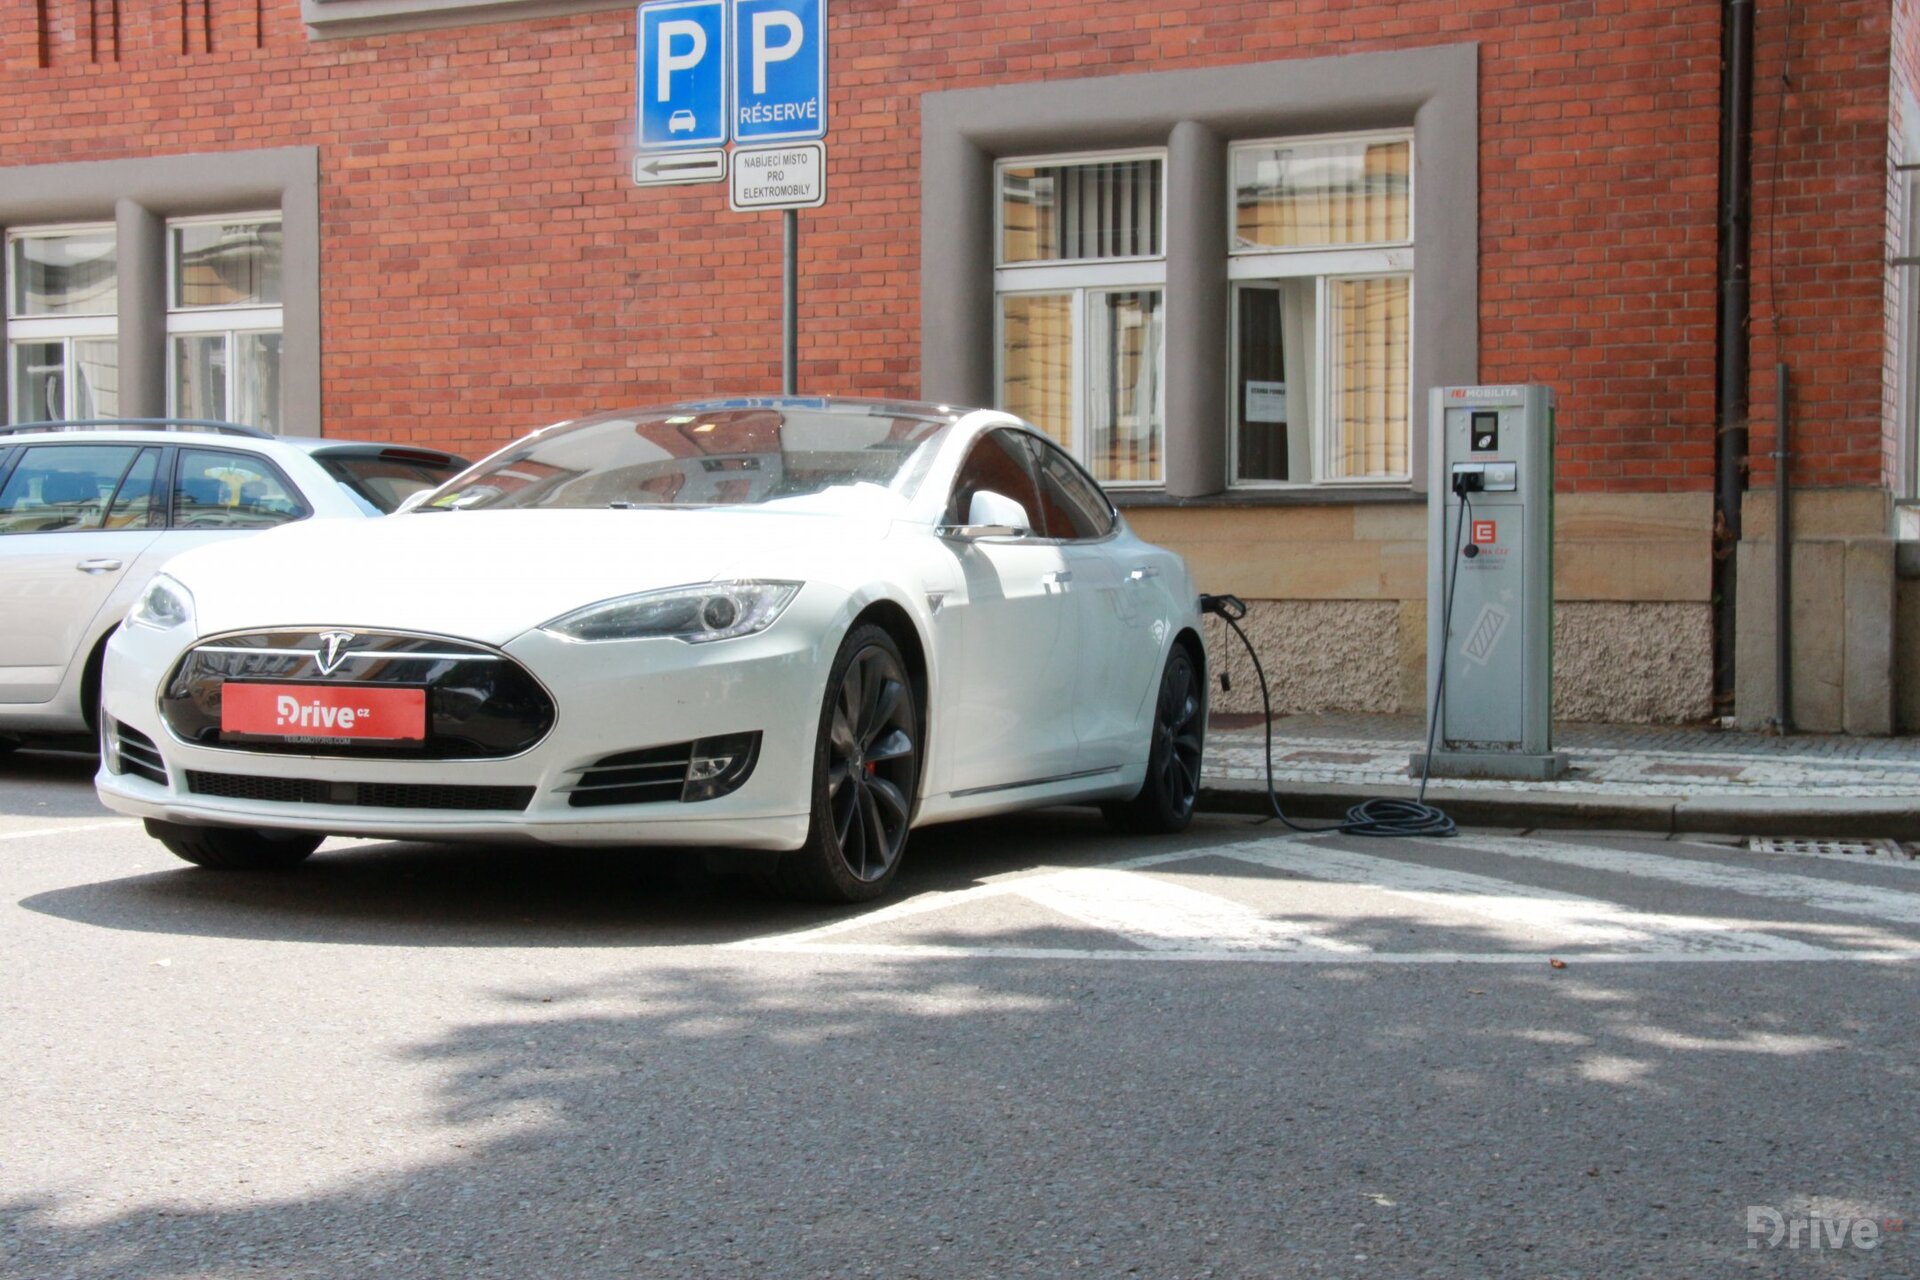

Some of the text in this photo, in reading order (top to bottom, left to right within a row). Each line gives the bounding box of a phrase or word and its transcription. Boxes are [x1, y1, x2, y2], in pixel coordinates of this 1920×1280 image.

[657, 19, 707, 102] P
[752, 10, 804, 95] P
[740, 98, 817, 124] RÉSERVÉ
[744, 152, 808, 168] NABÍJECÍ MÍSTO
[767, 170, 785, 182] PRO
[743, 184, 811, 199] ELEKTROMOBILY
[277, 695, 355, 728] Drive
